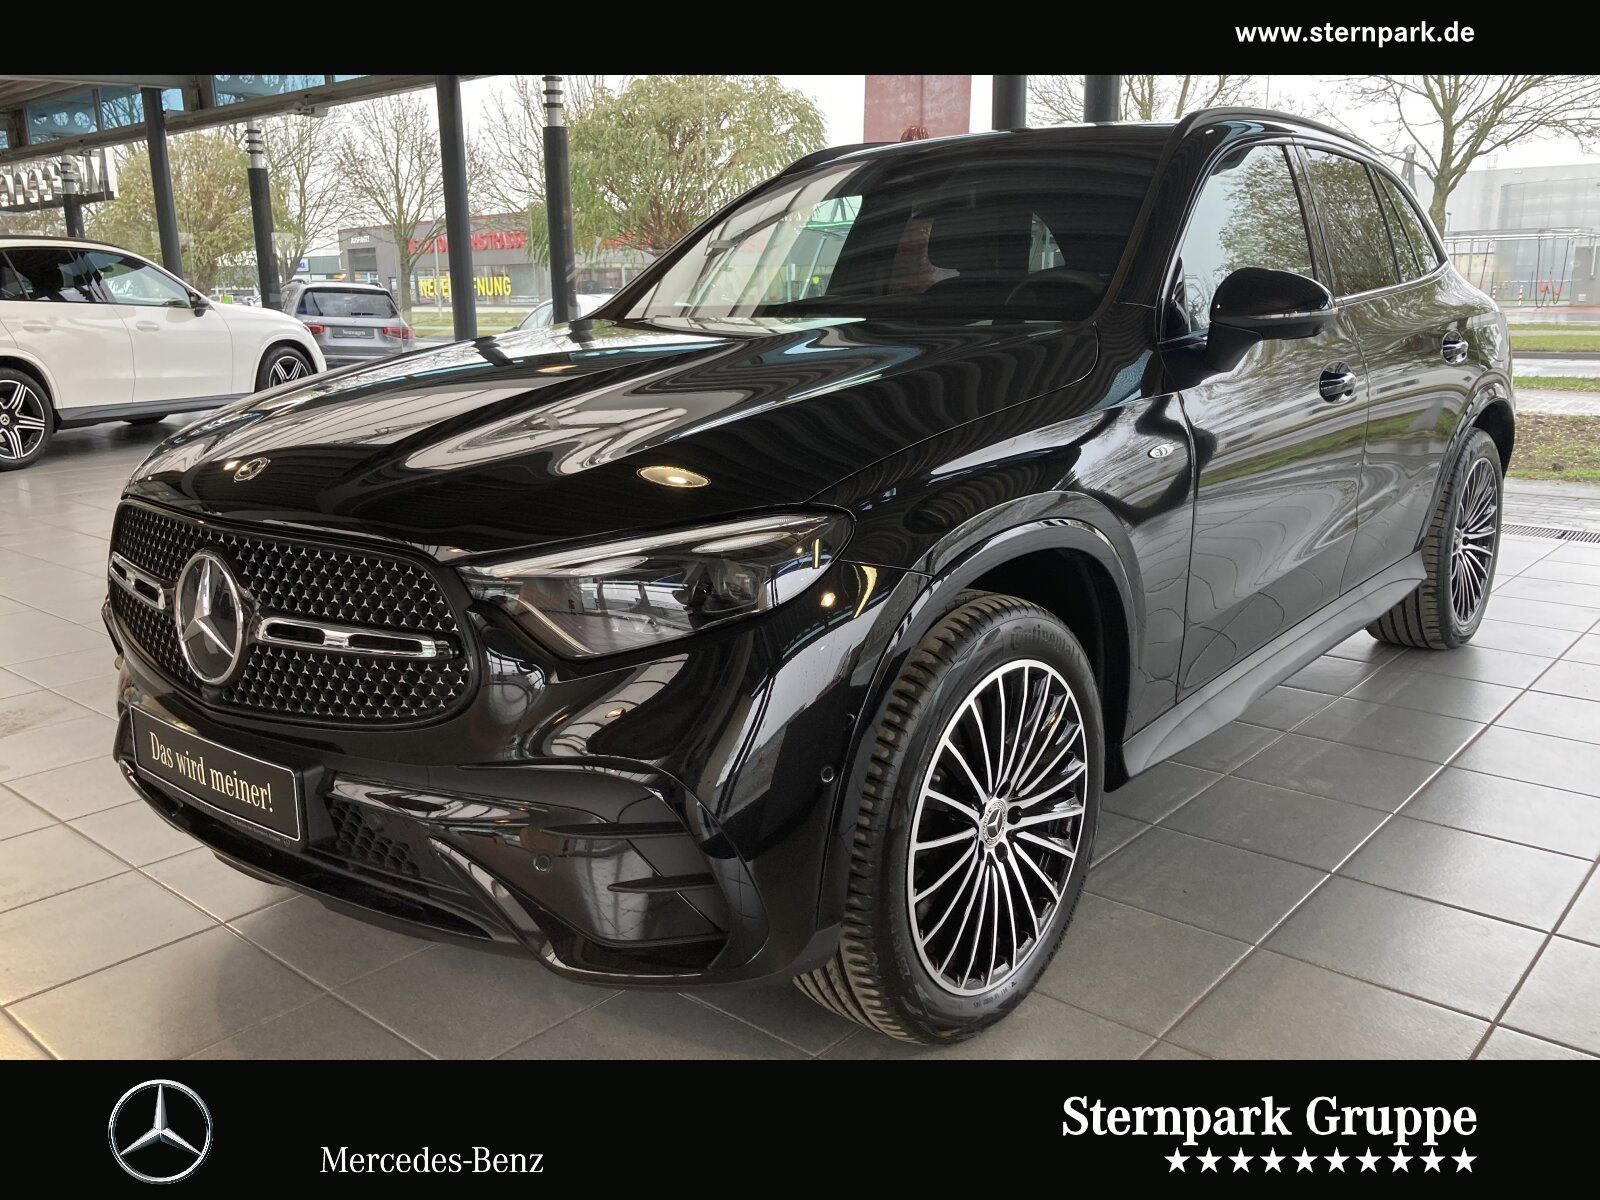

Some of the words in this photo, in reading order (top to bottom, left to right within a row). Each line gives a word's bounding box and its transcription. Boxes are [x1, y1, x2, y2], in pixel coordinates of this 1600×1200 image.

[149, 731, 173, 769] Das
[176, 751, 206, 786] wird
[210, 767, 273, 812] meiner!
